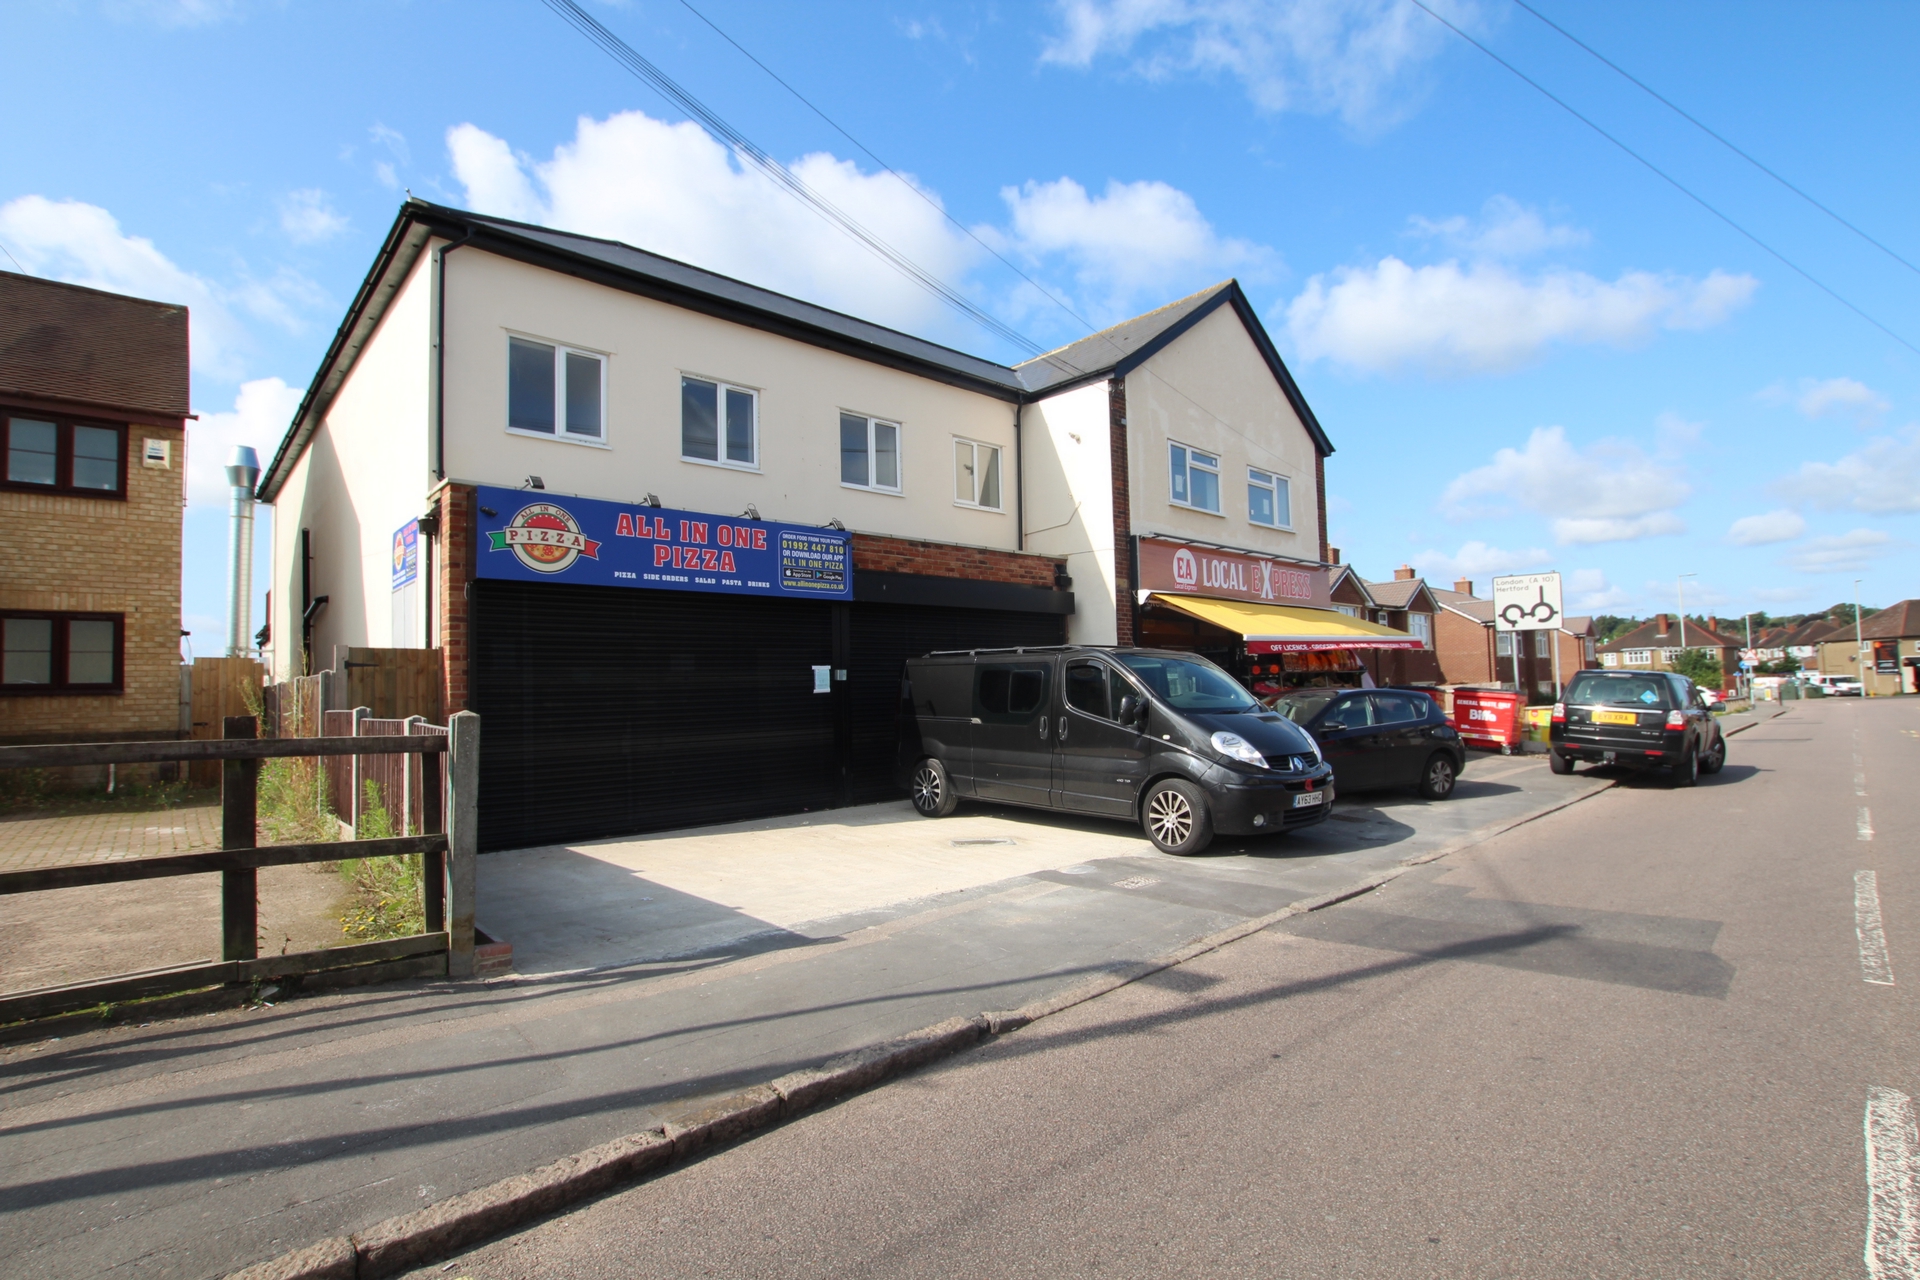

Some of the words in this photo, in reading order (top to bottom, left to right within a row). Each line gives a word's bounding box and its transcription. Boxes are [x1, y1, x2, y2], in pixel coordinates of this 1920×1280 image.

[520, 509, 535, 520] ALL
[555, 509, 571, 523] ONE
[508, 530, 581, 547] PIZZA
[616, 513, 671, 540] ALL
[680, 520, 708, 544] IN
[717, 525, 767, 550] ONE
[782, 540, 808, 550] 01992
[811, 543, 827, 552] 447
[829, 545, 844, 554] 810
[782, 549, 791, 557] OR
[791, 551, 821, 559] DOWNLOAD
[654, 544, 736, 572] PIZZA
[783, 557, 796, 566] ALL
[798, 559, 807, 567] IN
[808, 559, 823, 568] ONE
[824, 561, 844, 570] PIZZA
[1176, 557, 1193, 580] EA
[614, 571, 637, 579] PIZZA
[643, 573, 660, 581] SIDE
[661, 574, 689, 582] ORDERS
[1202, 558, 1247, 591] LOCAL
[1251, 559, 1311, 599] EXPRESS
